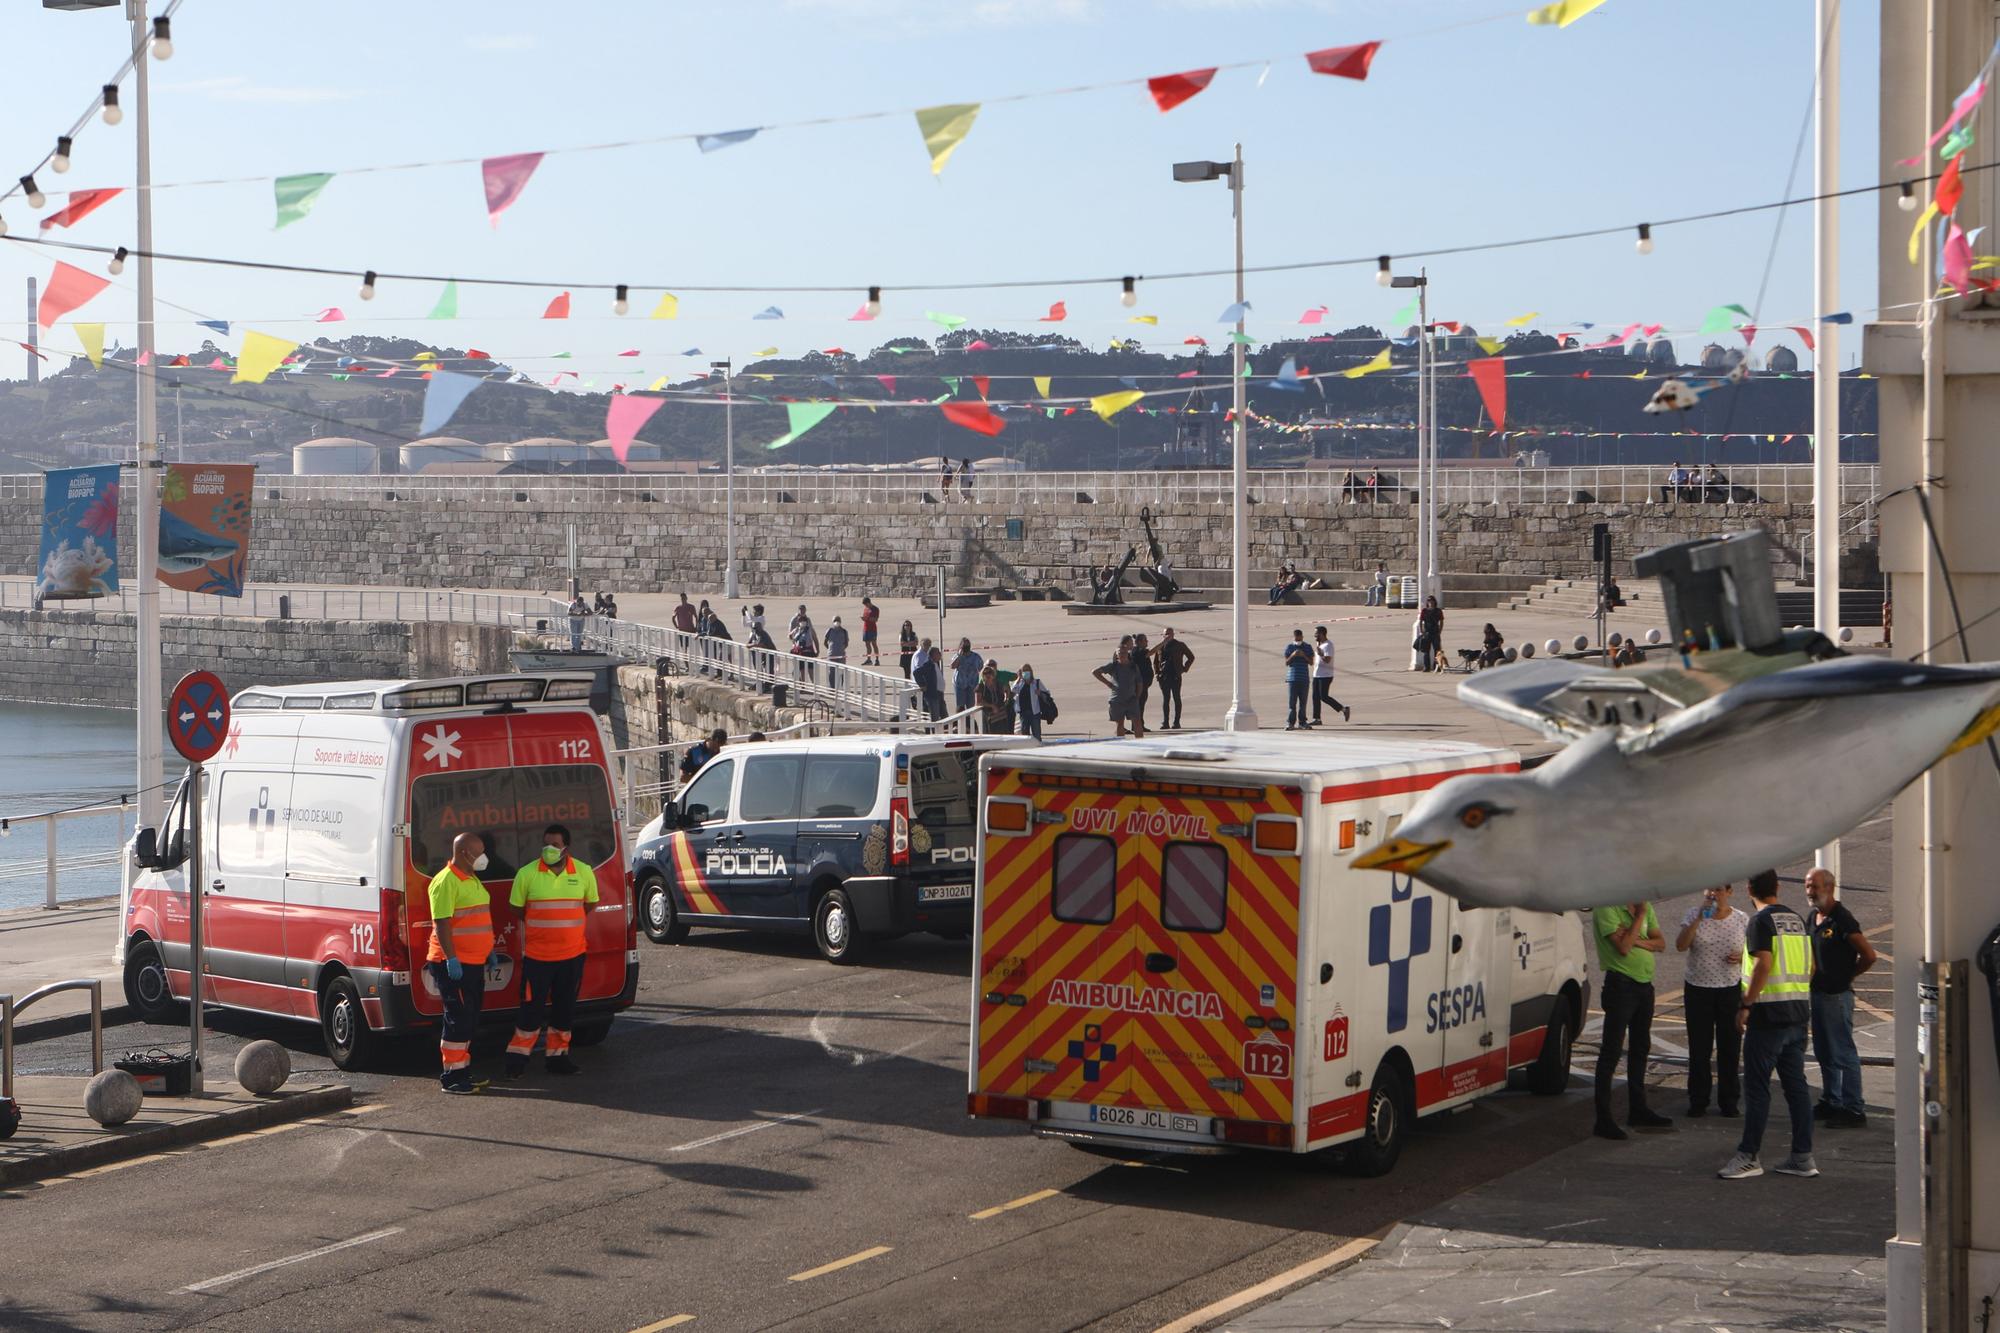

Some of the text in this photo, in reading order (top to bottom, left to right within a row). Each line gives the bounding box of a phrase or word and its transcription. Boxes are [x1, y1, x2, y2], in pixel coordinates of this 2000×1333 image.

[69, 477, 96, 487] ACUARIO
[193, 474, 225, 483] ACUARIO
[314, 748, 384, 766] Soporte vital básico
[559, 739, 591, 758] 112
[282, 808, 343, 824] SERVICIO DE SALUD
[440, 799, 590, 829] Ambulancia
[1071, 807, 1210, 839] UVI MÓVIL
[706, 849, 787, 875] POLICÍA
[350, 923, 375, 954] 112
[1048, 979, 1223, 1020] AMBULANCIA
[1426, 981, 1486, 1034] SESPA
[1327, 1030, 1345, 1057] 112
[1250, 1052, 1283, 1073] 112
[1100, 1107, 1166, 1128] 6026 JCL
[1176, 1119, 1195, 1130] SP
